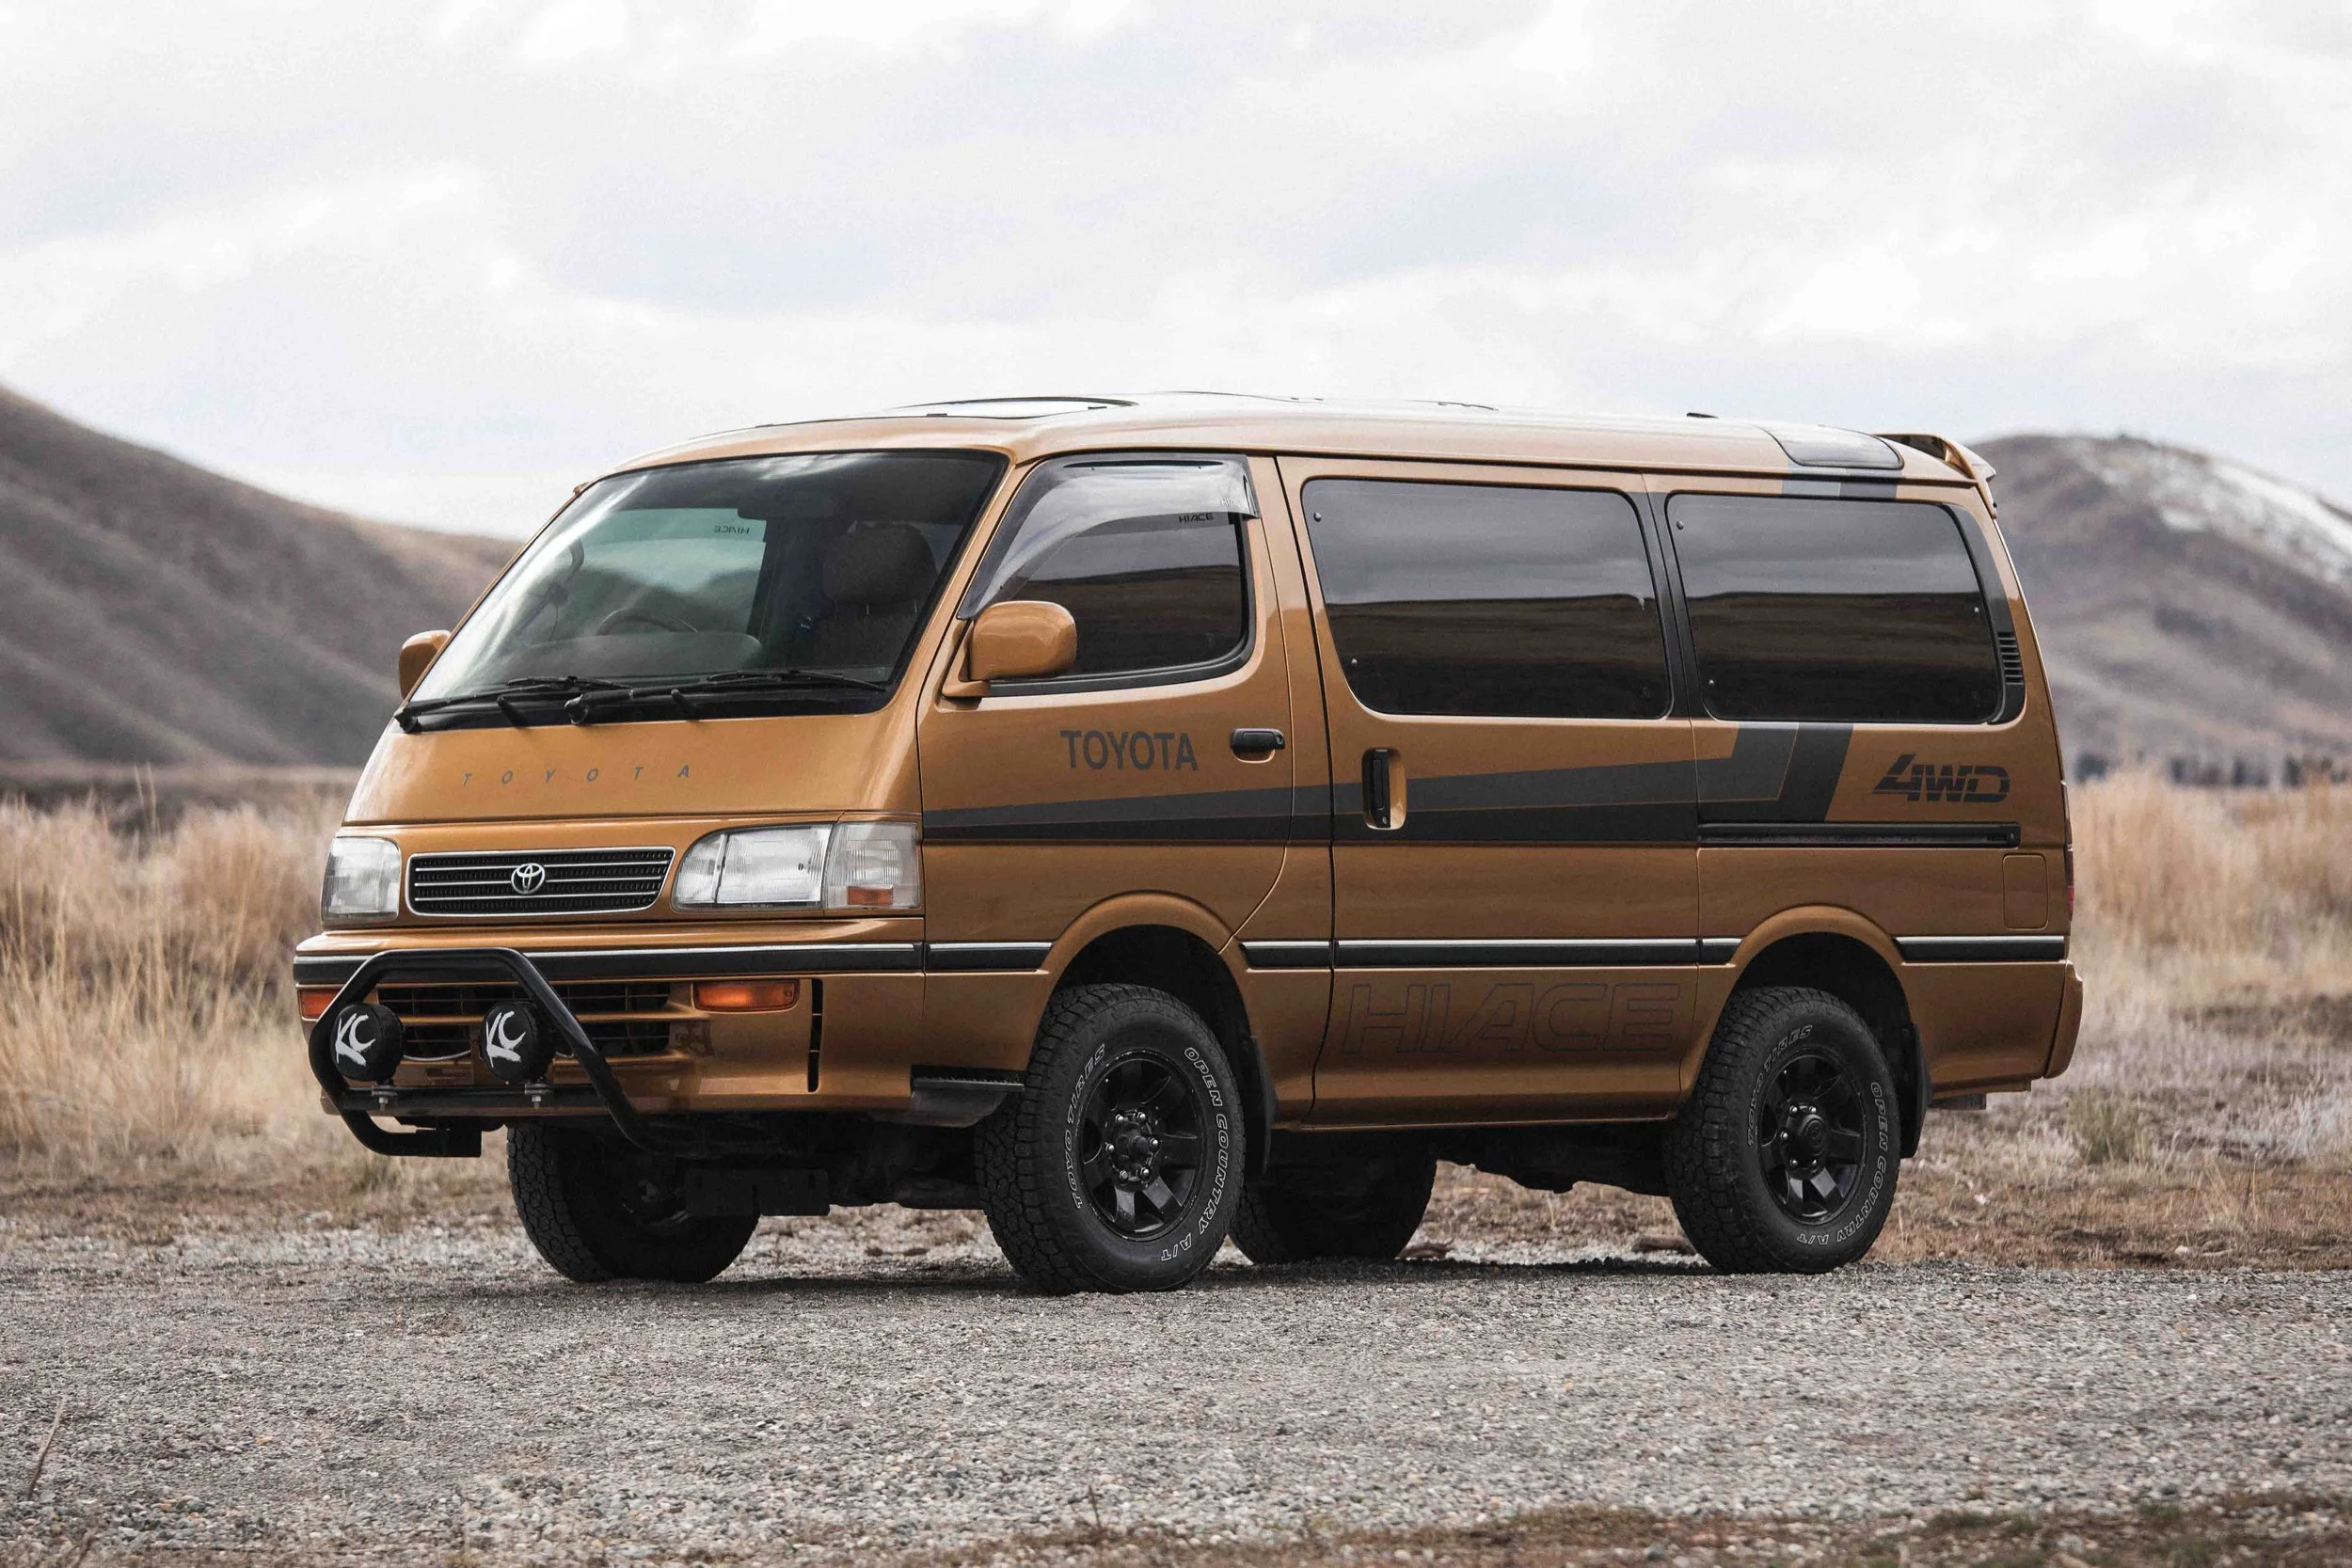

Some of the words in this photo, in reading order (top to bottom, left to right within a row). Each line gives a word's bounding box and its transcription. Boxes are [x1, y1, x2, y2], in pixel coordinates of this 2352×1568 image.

[1178, 512, 1214, 523] HIACE
[462, 764, 690, 786] TOYOTA
[1060, 730, 1199, 770] TOYOTA
[1871, 753, 2010, 803] 4WD
[335, 1012, 376, 1067] KC
[485, 1011, 527, 1068] KC
[1343, 983, 1680, 1053] HIACE
[1067, 1043, 1105, 1124] TIRES
[1184, 1047, 1223, 1106] OPEN
[1870, 1082, 1888, 1151] OPEN
[1065, 1130, 1083, 1209] TOYO
[1199, 1113, 1229, 1235] COUNTRY
[1836, 1155, 1887, 1243] COUNTRY
[1160, 1232, 1192, 1261] A/T
[1796, 1233, 1829, 1244] A/T
